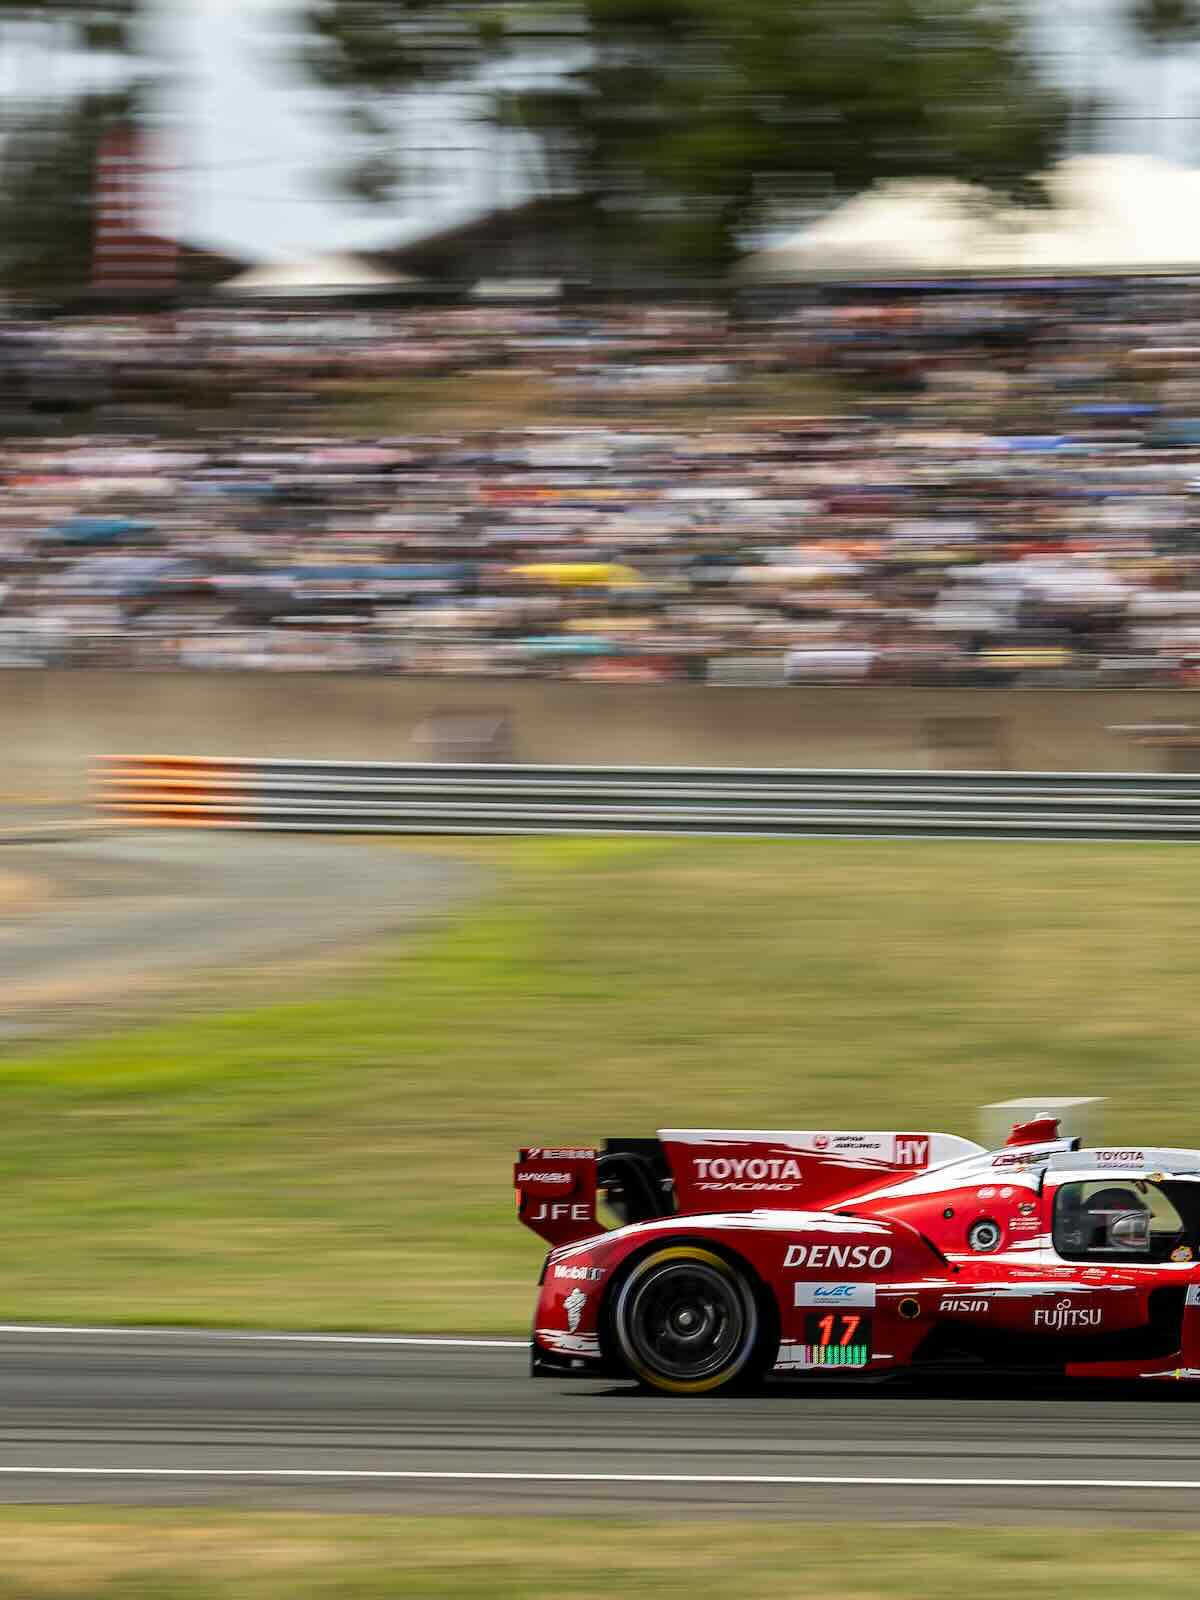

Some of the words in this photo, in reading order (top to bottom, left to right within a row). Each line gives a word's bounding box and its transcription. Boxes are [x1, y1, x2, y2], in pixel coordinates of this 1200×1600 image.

[896, 1139, 928, 1165] HY
[1095, 1151, 1144, 1161] TOYOTA
[693, 1158, 802, 1179] TOYOTA
[694, 1183, 803, 1192] RACING
[530, 1204, 592, 1220] JFE
[783, 1245, 892, 1269] DENSO
[814, 1285, 857, 1297] WEC
[939, 1300, 989, 1313] AISIN
[1034, 1305, 1102, 1330] FUJITSU
[818, 1314, 861, 1346] 17
